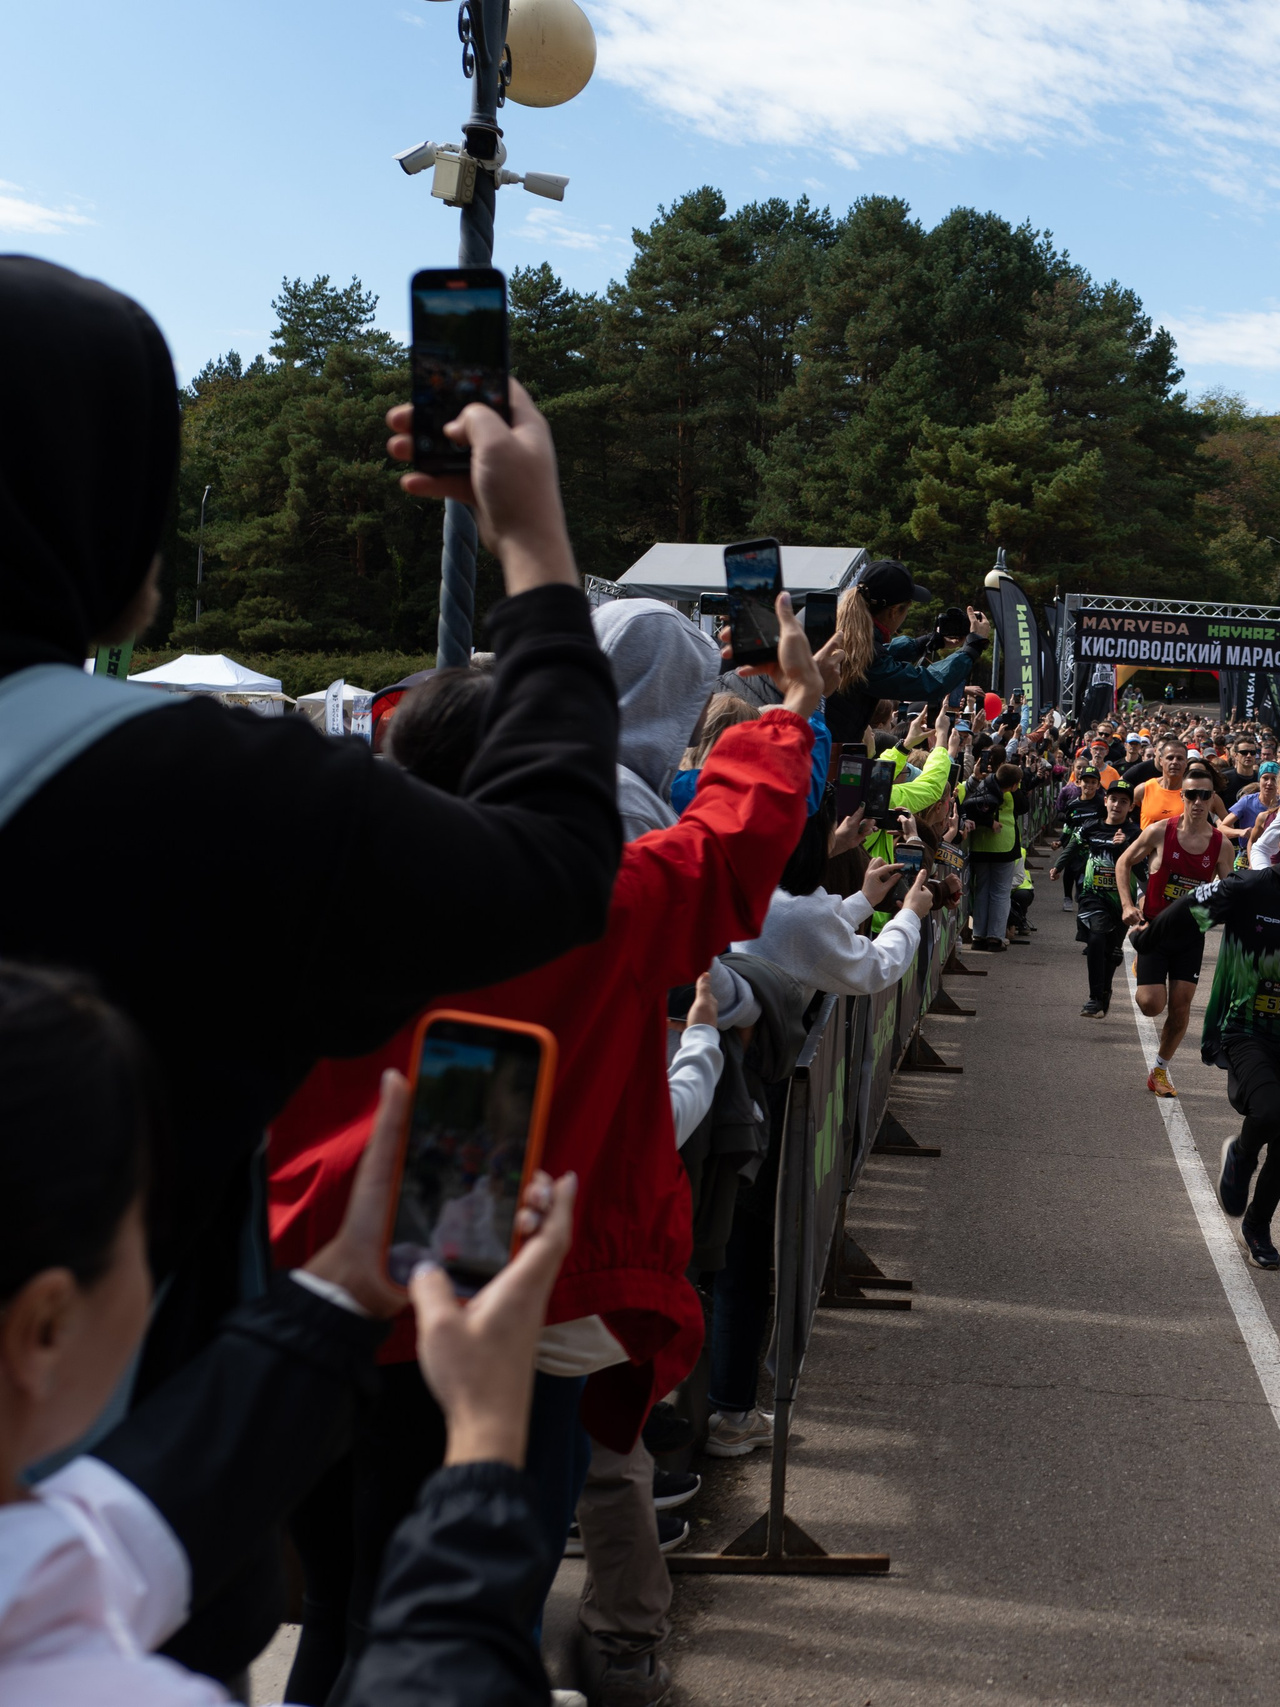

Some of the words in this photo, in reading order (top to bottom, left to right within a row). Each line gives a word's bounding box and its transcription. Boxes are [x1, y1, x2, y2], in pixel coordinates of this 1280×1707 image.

[1082, 616, 1190, 636] MAYRVEDA
[1080, 636, 1223, 664] КИСЛОВОДСКИЙ
[937, 849, 959, 865] 2014
